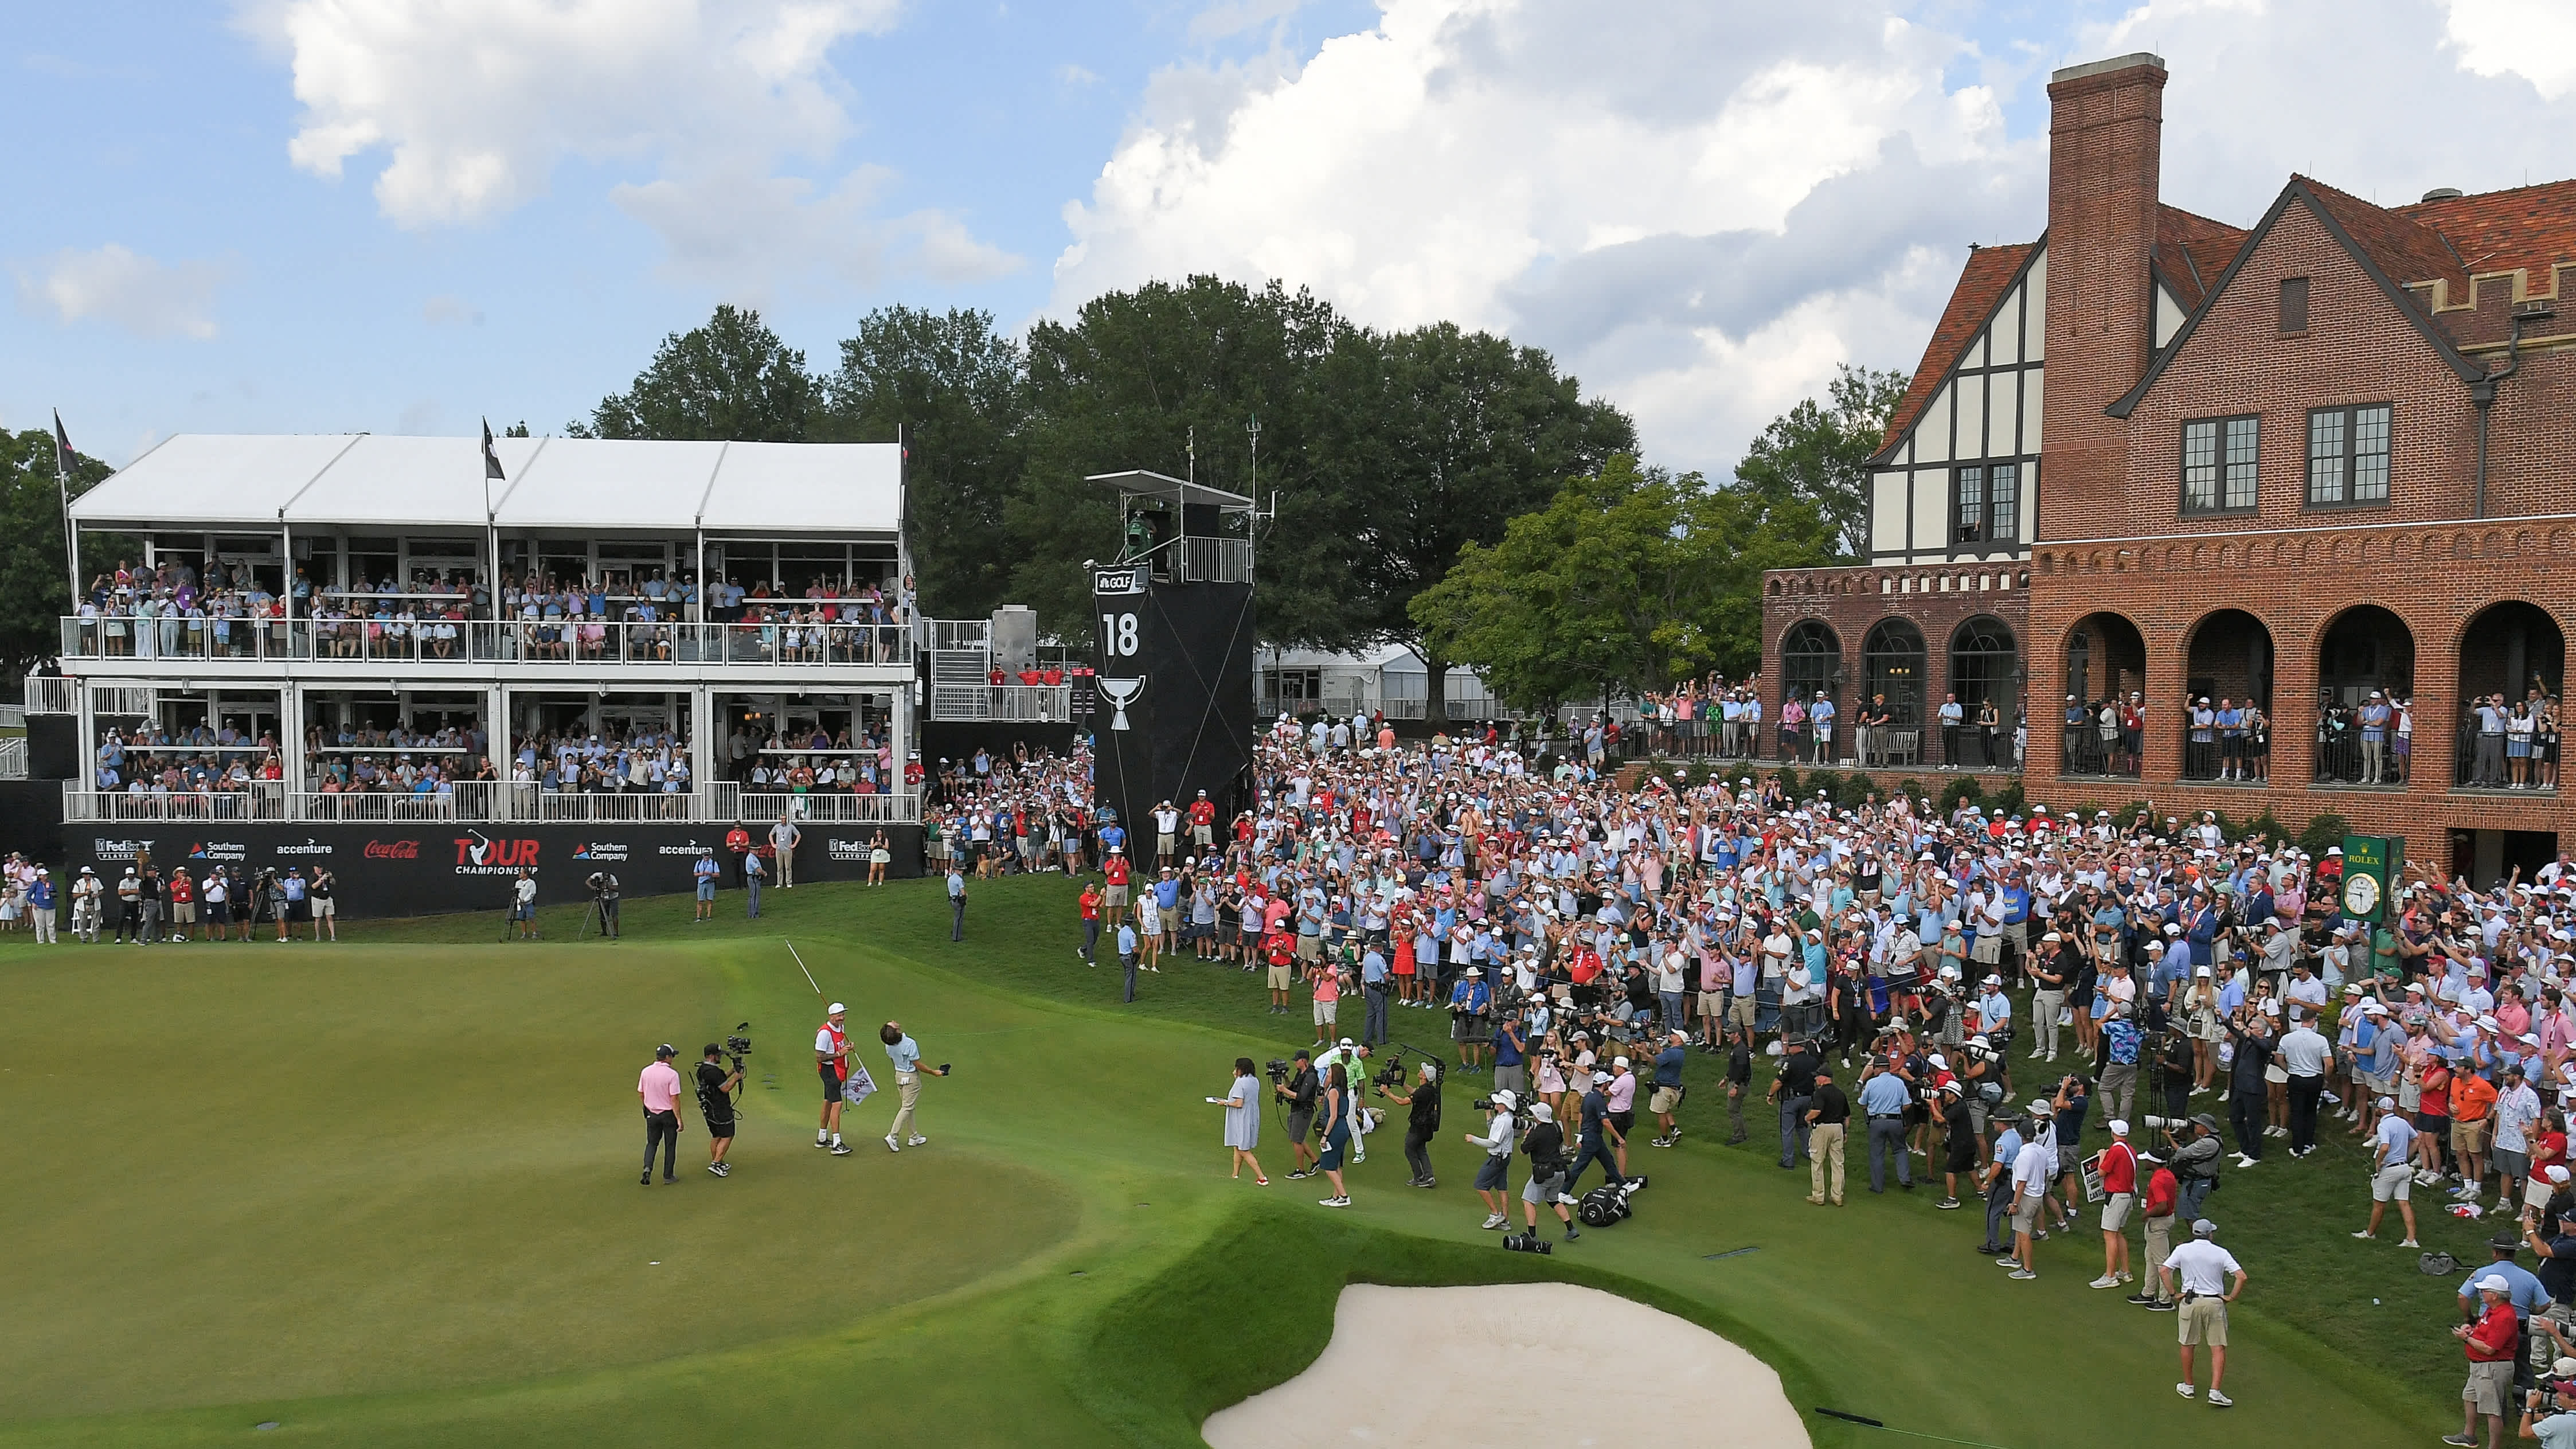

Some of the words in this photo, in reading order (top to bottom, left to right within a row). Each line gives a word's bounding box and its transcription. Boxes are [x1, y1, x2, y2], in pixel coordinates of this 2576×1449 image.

[1110, 576, 1131, 588] GOLF
[1103, 613, 1138, 656] 18
[105, 840, 139, 851] FedEx
[207, 842, 245, 851] Southern
[276, 844, 333, 854] accenture
[591, 842, 627, 852] Southern
[839, 841, 871, 852] FedEx
[207, 851, 245, 861] Company
[454, 839, 540, 866] TOUR
[591, 851, 628, 861] Company
[2348, 855, 2379, 865] ROLEX
[455, 866, 538, 874] CHAMPIONSIP
